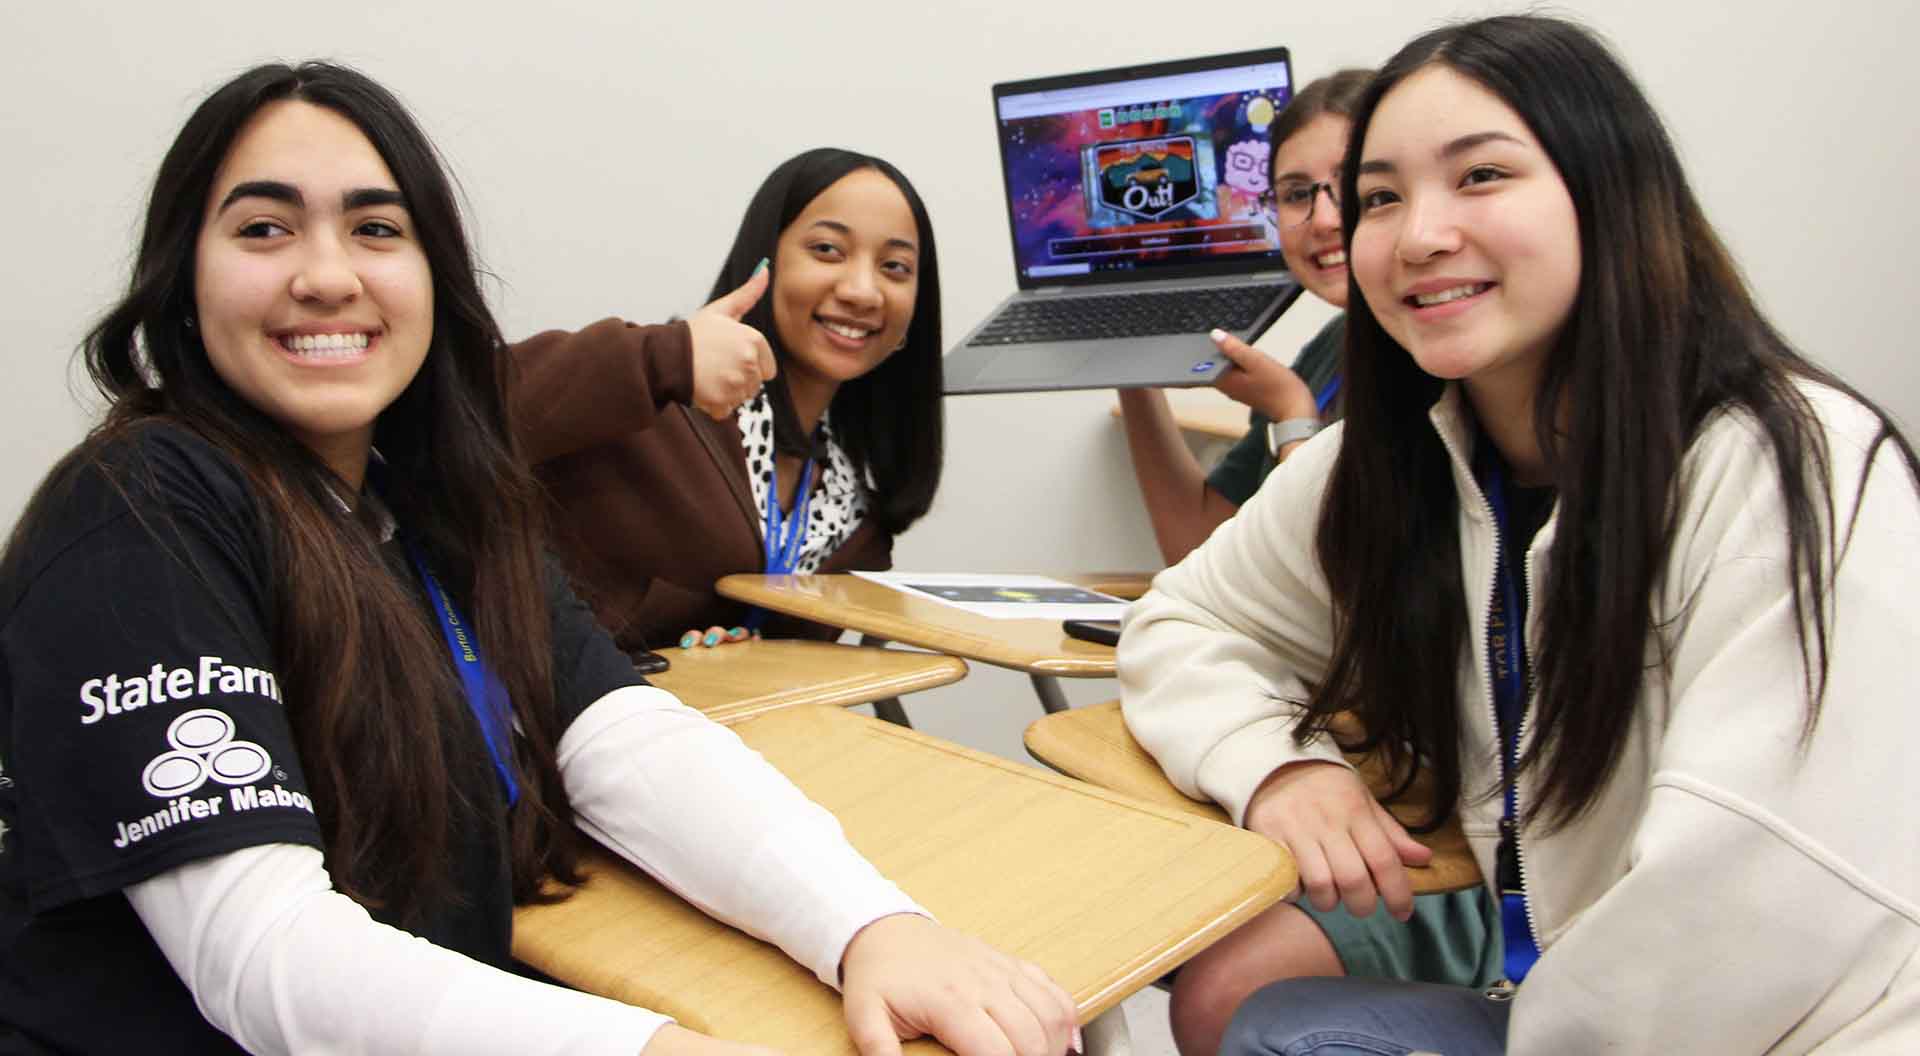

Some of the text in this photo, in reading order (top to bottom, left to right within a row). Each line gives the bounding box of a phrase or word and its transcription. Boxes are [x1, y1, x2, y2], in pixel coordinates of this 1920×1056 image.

[1123, 183, 1174, 211] Out!
[80, 663, 193, 724] State
[113, 795, 222, 848] Jennifer
